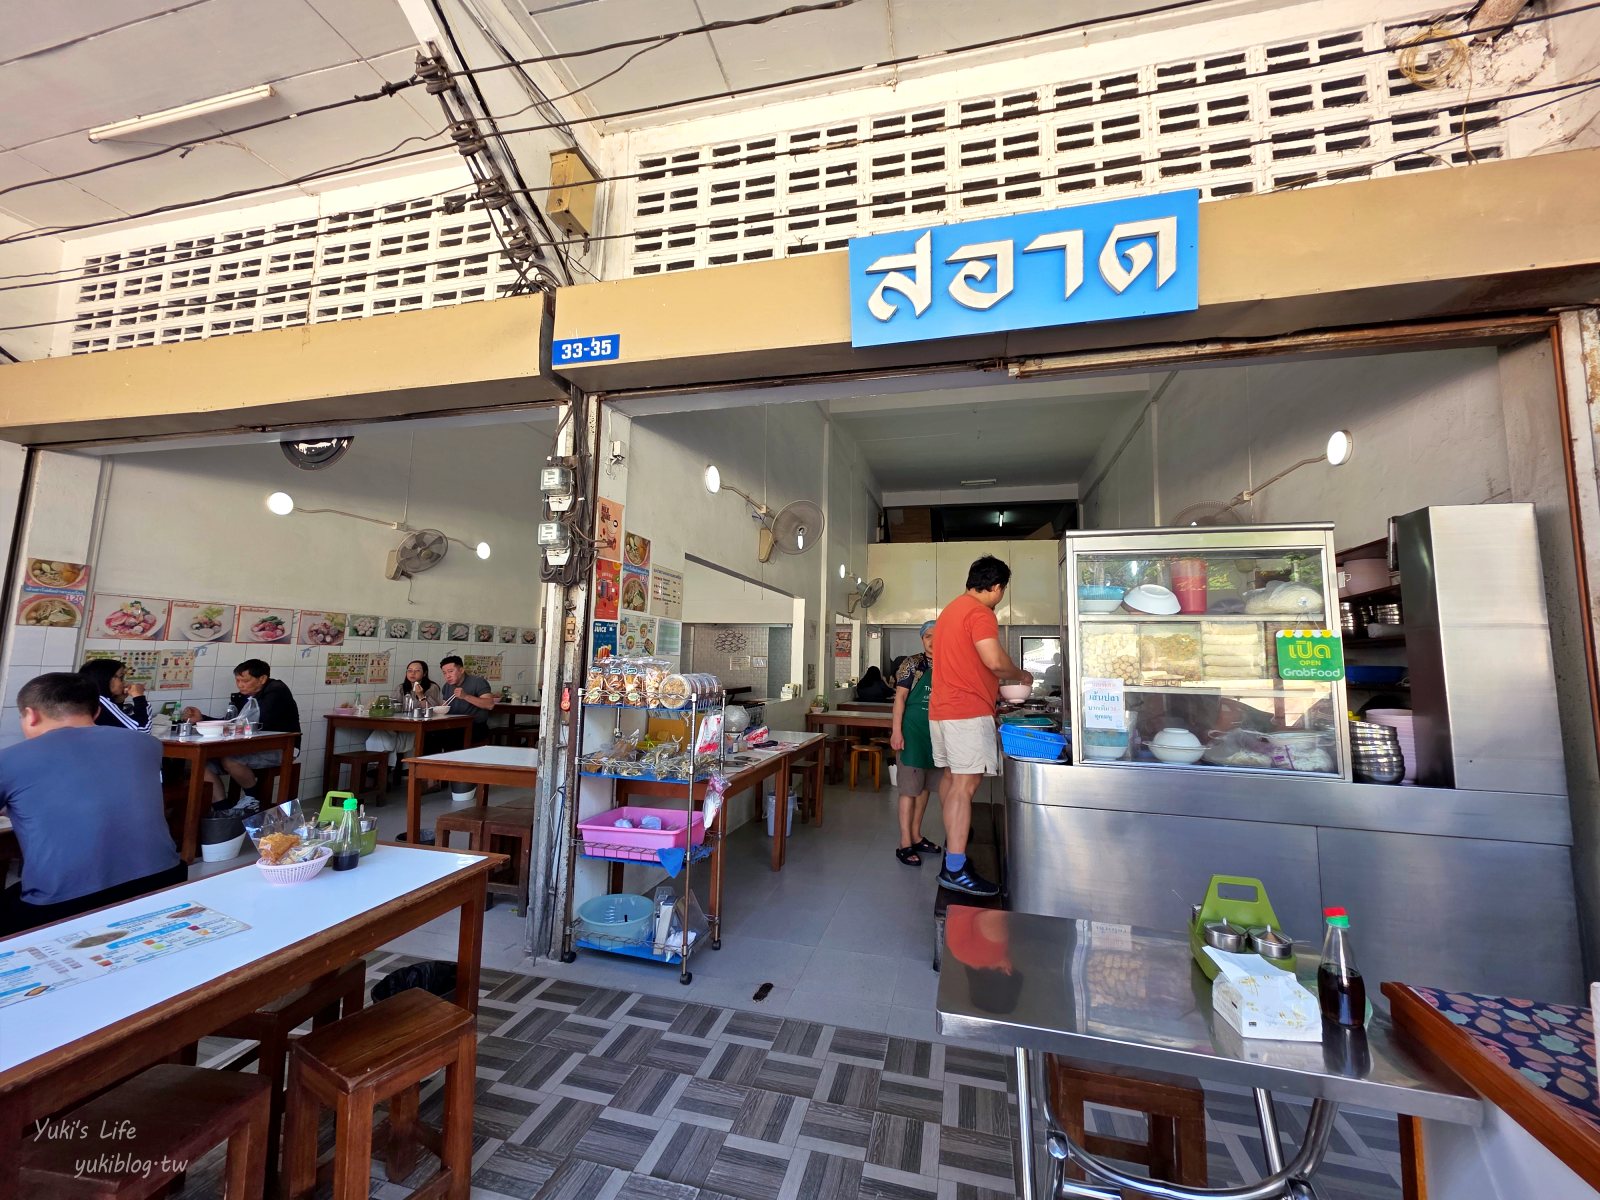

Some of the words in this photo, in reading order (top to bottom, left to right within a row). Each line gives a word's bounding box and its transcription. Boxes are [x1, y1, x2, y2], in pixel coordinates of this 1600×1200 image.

[865, 215, 1178, 322] สอาด
[561, 339, 612, 360] 33-35
[593, 625, 607, 633] JUICE
[1288, 640, 1331, 659] เปิด
[1283, 668, 1340, 677] GrabFood
